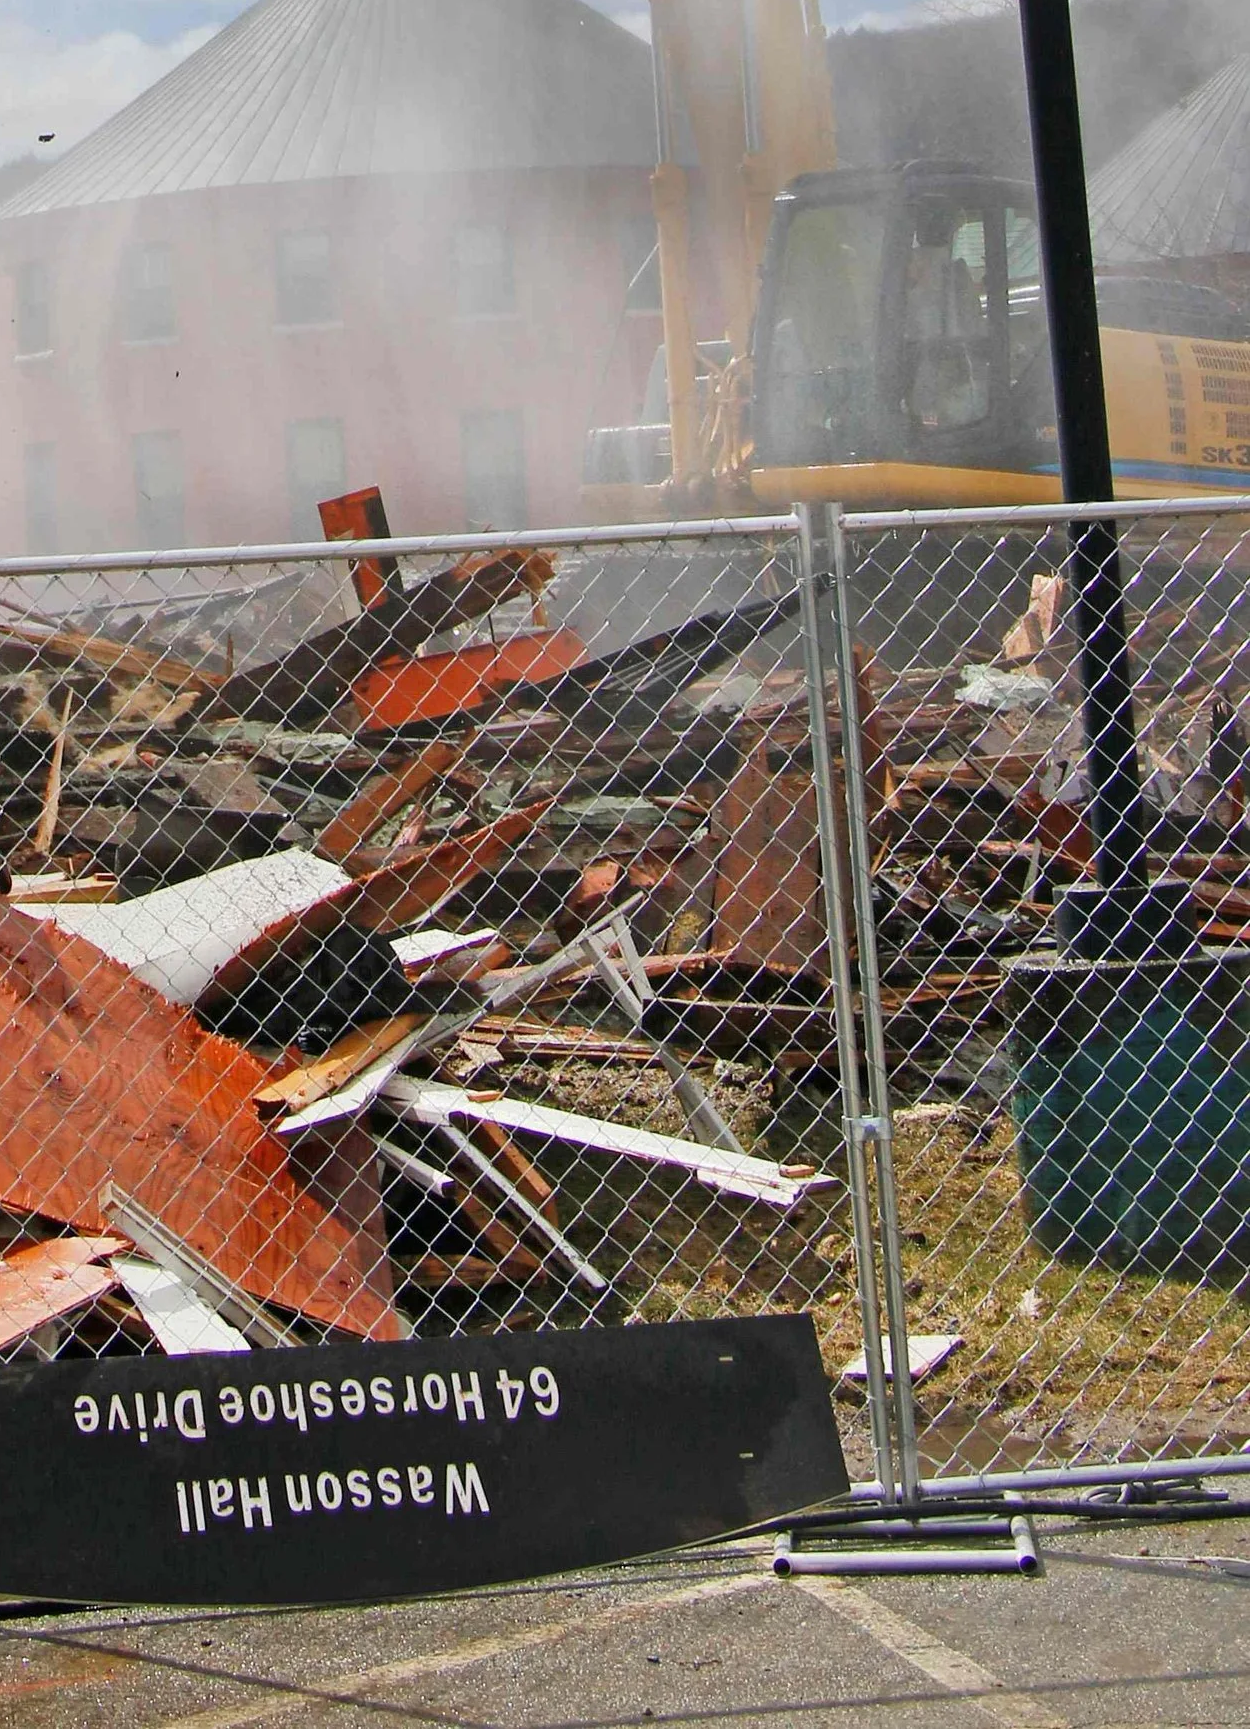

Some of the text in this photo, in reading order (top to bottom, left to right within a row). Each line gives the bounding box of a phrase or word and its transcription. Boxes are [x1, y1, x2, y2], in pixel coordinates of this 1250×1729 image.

[74, 1366, 561, 1443] 64 Horseshoe Drive
[176, 1462, 491, 1533] Wasson Hall
